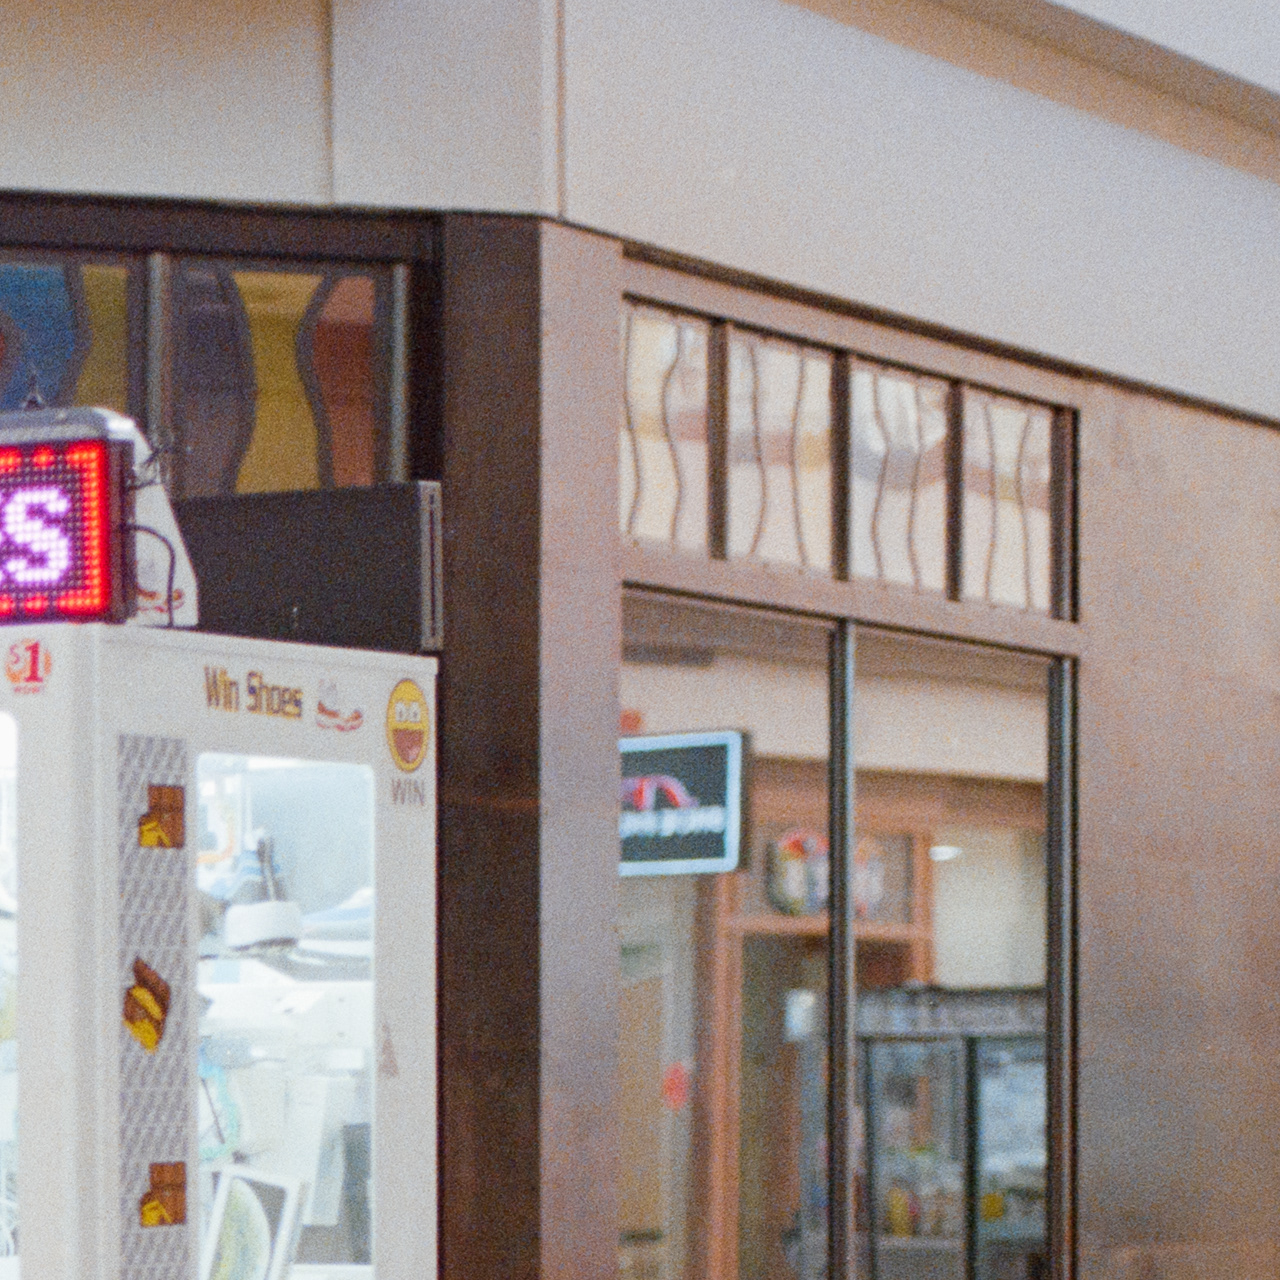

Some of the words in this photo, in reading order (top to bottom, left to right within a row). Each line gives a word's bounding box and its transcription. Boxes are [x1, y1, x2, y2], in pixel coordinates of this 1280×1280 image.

[203, 664, 240, 714] Win
[245, 669, 304, 721] Shoes
[390, 777, 426, 807] WIN
